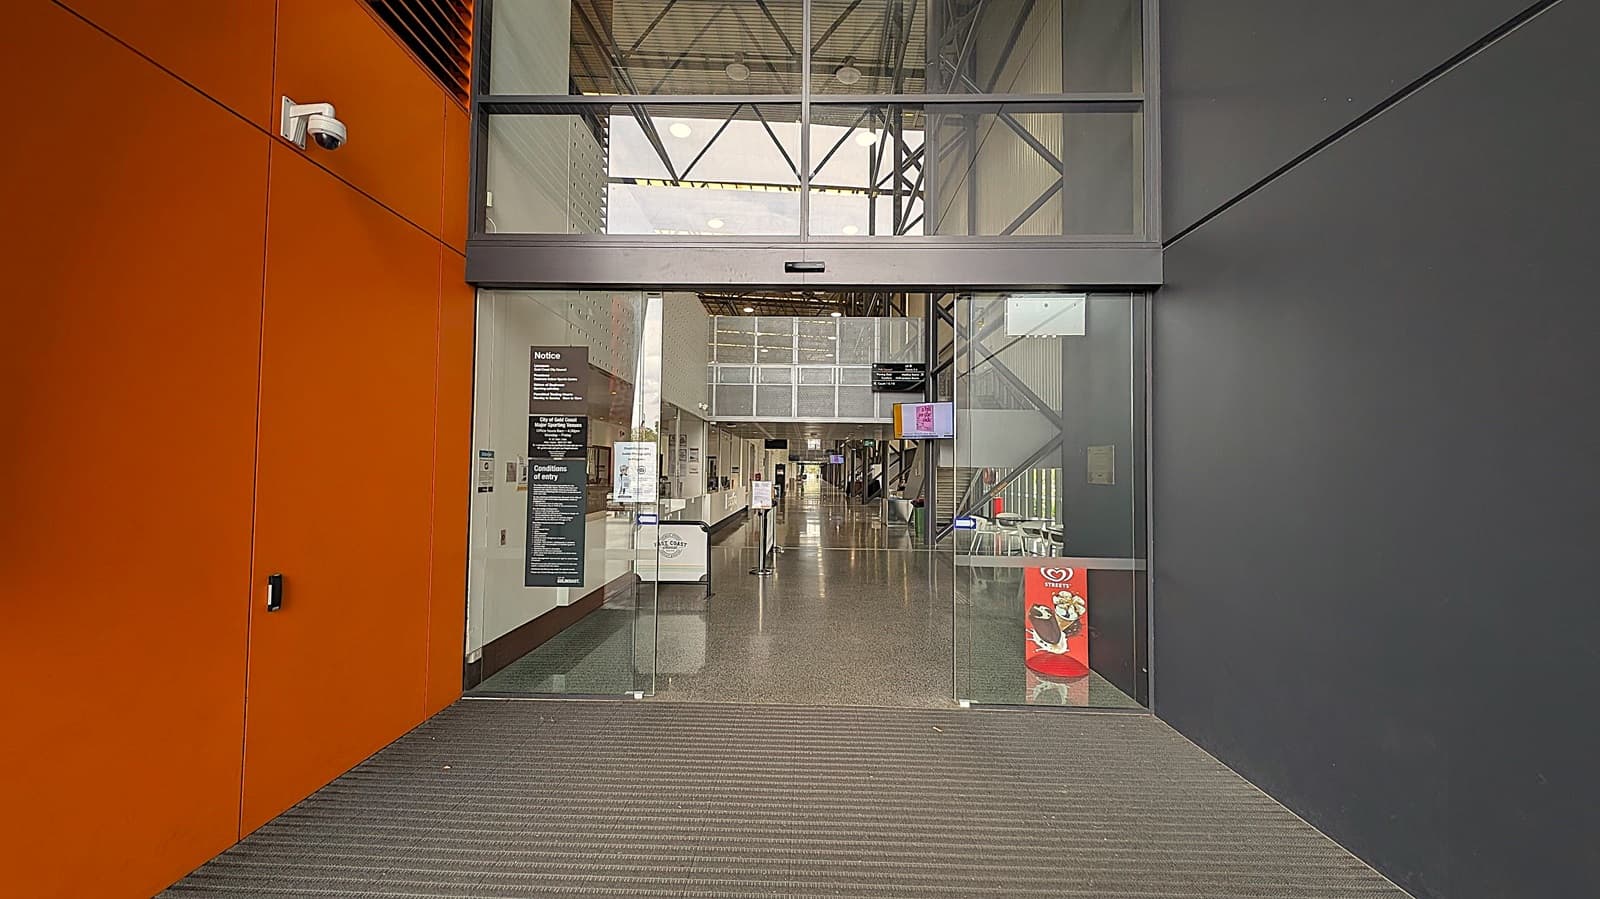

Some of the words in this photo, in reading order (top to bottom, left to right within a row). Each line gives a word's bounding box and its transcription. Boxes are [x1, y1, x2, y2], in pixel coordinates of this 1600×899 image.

[534, 351, 560, 360] Notice
[533, 464, 568, 472] Conditions
[541, 473, 559, 482] entry
